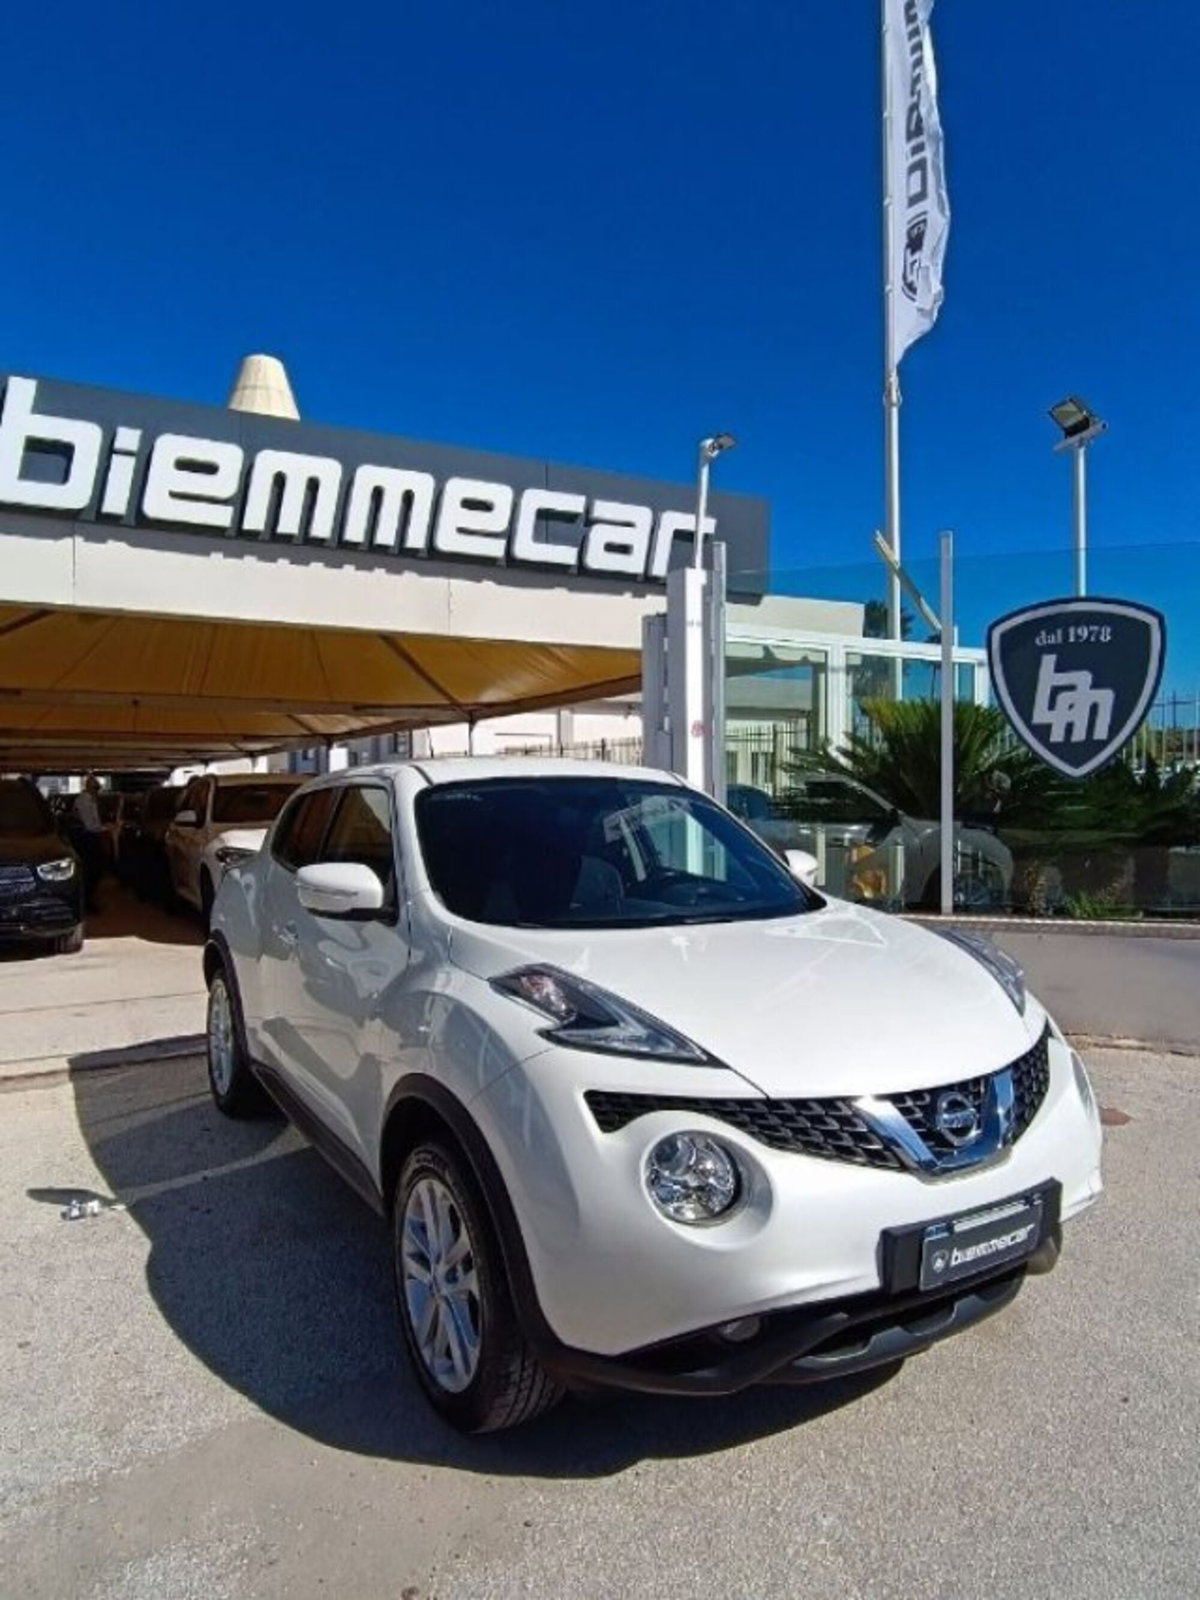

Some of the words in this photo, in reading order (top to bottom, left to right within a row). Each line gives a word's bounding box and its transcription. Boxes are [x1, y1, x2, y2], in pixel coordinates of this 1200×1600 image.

[0, 375, 717, 577] biemmecar
[1035, 628, 1063, 646] dal
[1067, 625, 1112, 643] 1978
